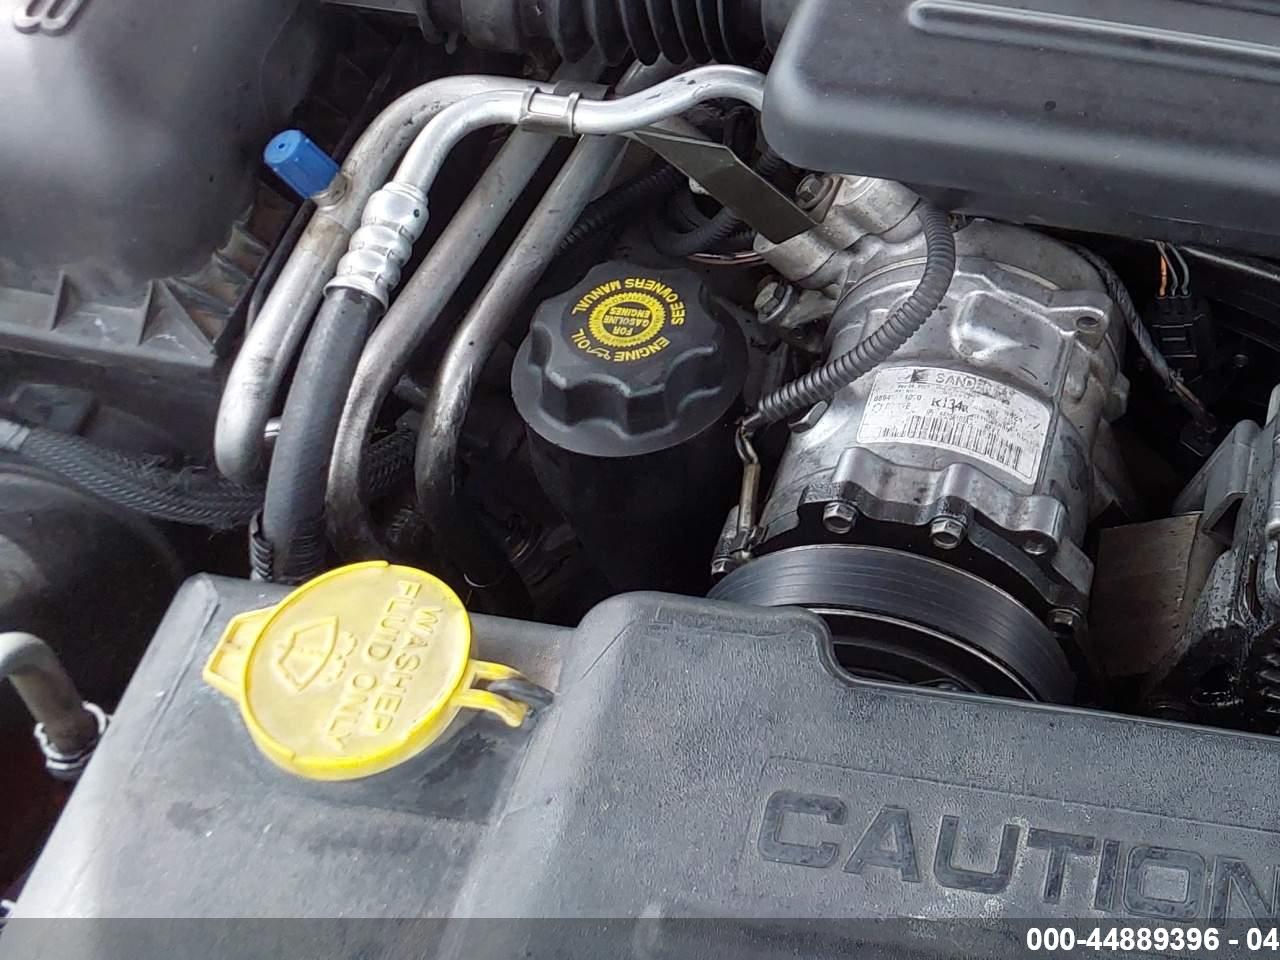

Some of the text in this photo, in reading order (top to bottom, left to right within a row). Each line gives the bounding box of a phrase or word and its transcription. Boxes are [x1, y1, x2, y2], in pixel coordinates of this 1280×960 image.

[571, 279, 622, 315] MANUAL
[624, 277, 679, 303] OWNERS
[603, 314, 650, 328] GASOLINE
[608, 306, 652, 319] ENGINES
[669, 300, 687, 326] SEE
[571, 327, 591, 349] OIL
[612, 325, 634, 336] FOR
[613, 336, 671, 362] ENGINE
[325, 579, 423, 752] FLUID ONLY
[371, 604, 445, 736] WASHER
